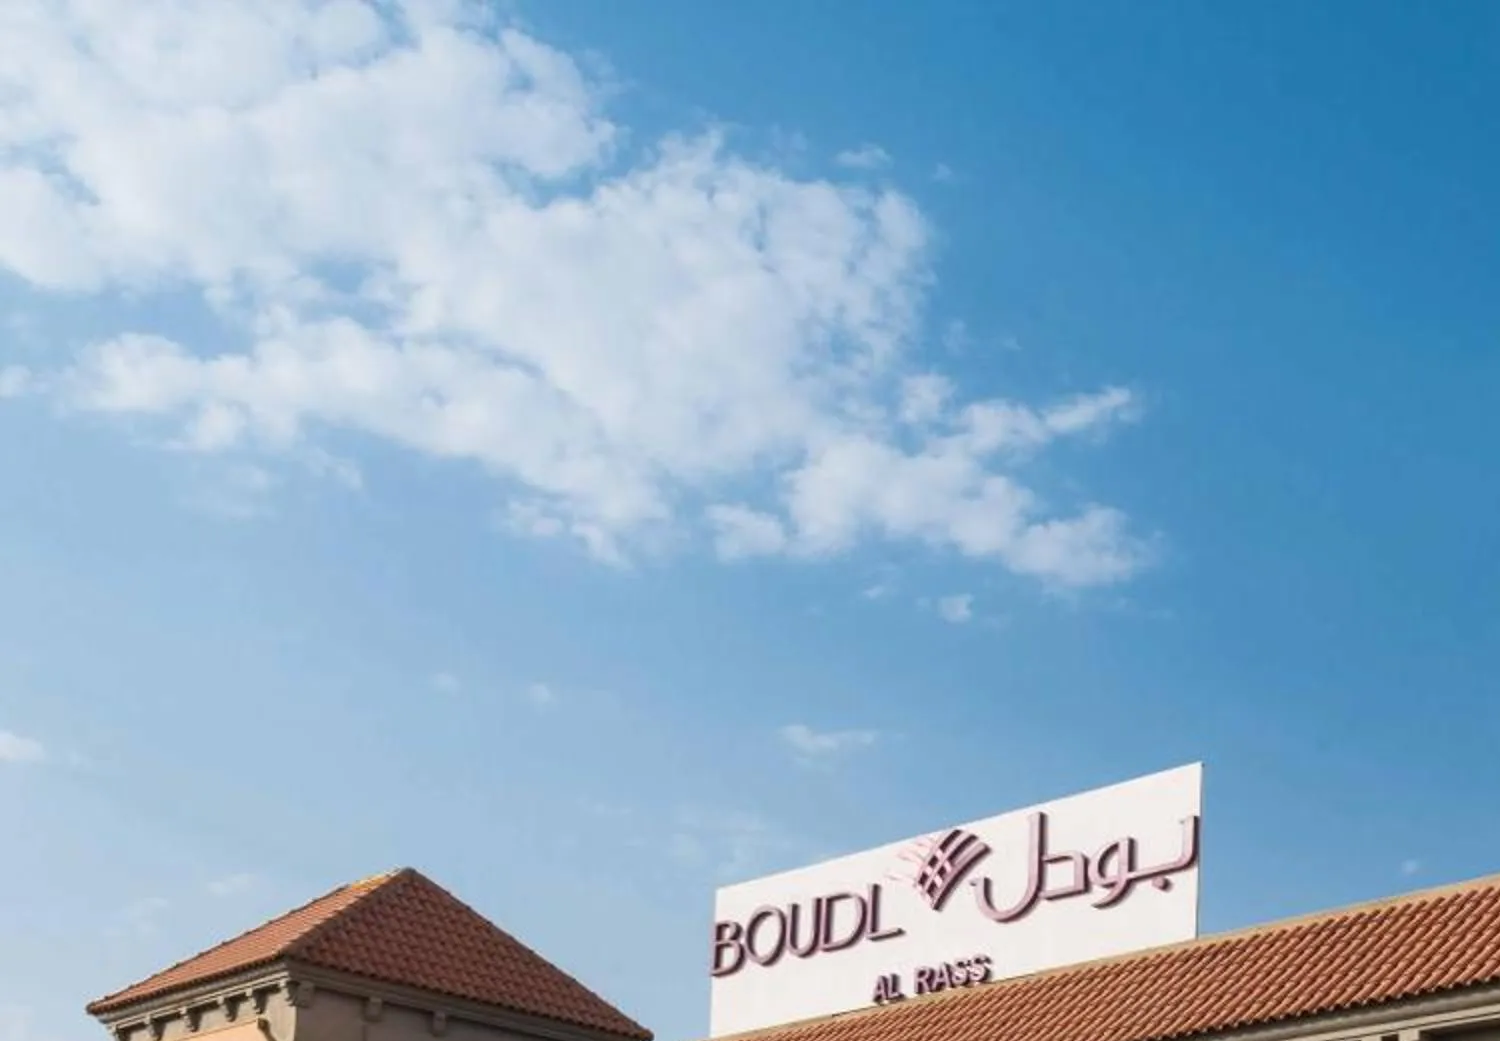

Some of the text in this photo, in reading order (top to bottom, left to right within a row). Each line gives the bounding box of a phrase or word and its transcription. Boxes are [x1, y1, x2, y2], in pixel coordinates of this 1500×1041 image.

[971, 811, 1199, 922] بودل
[712, 884, 905, 976] BOUDL
[873, 955, 992, 1004] AL RASS
